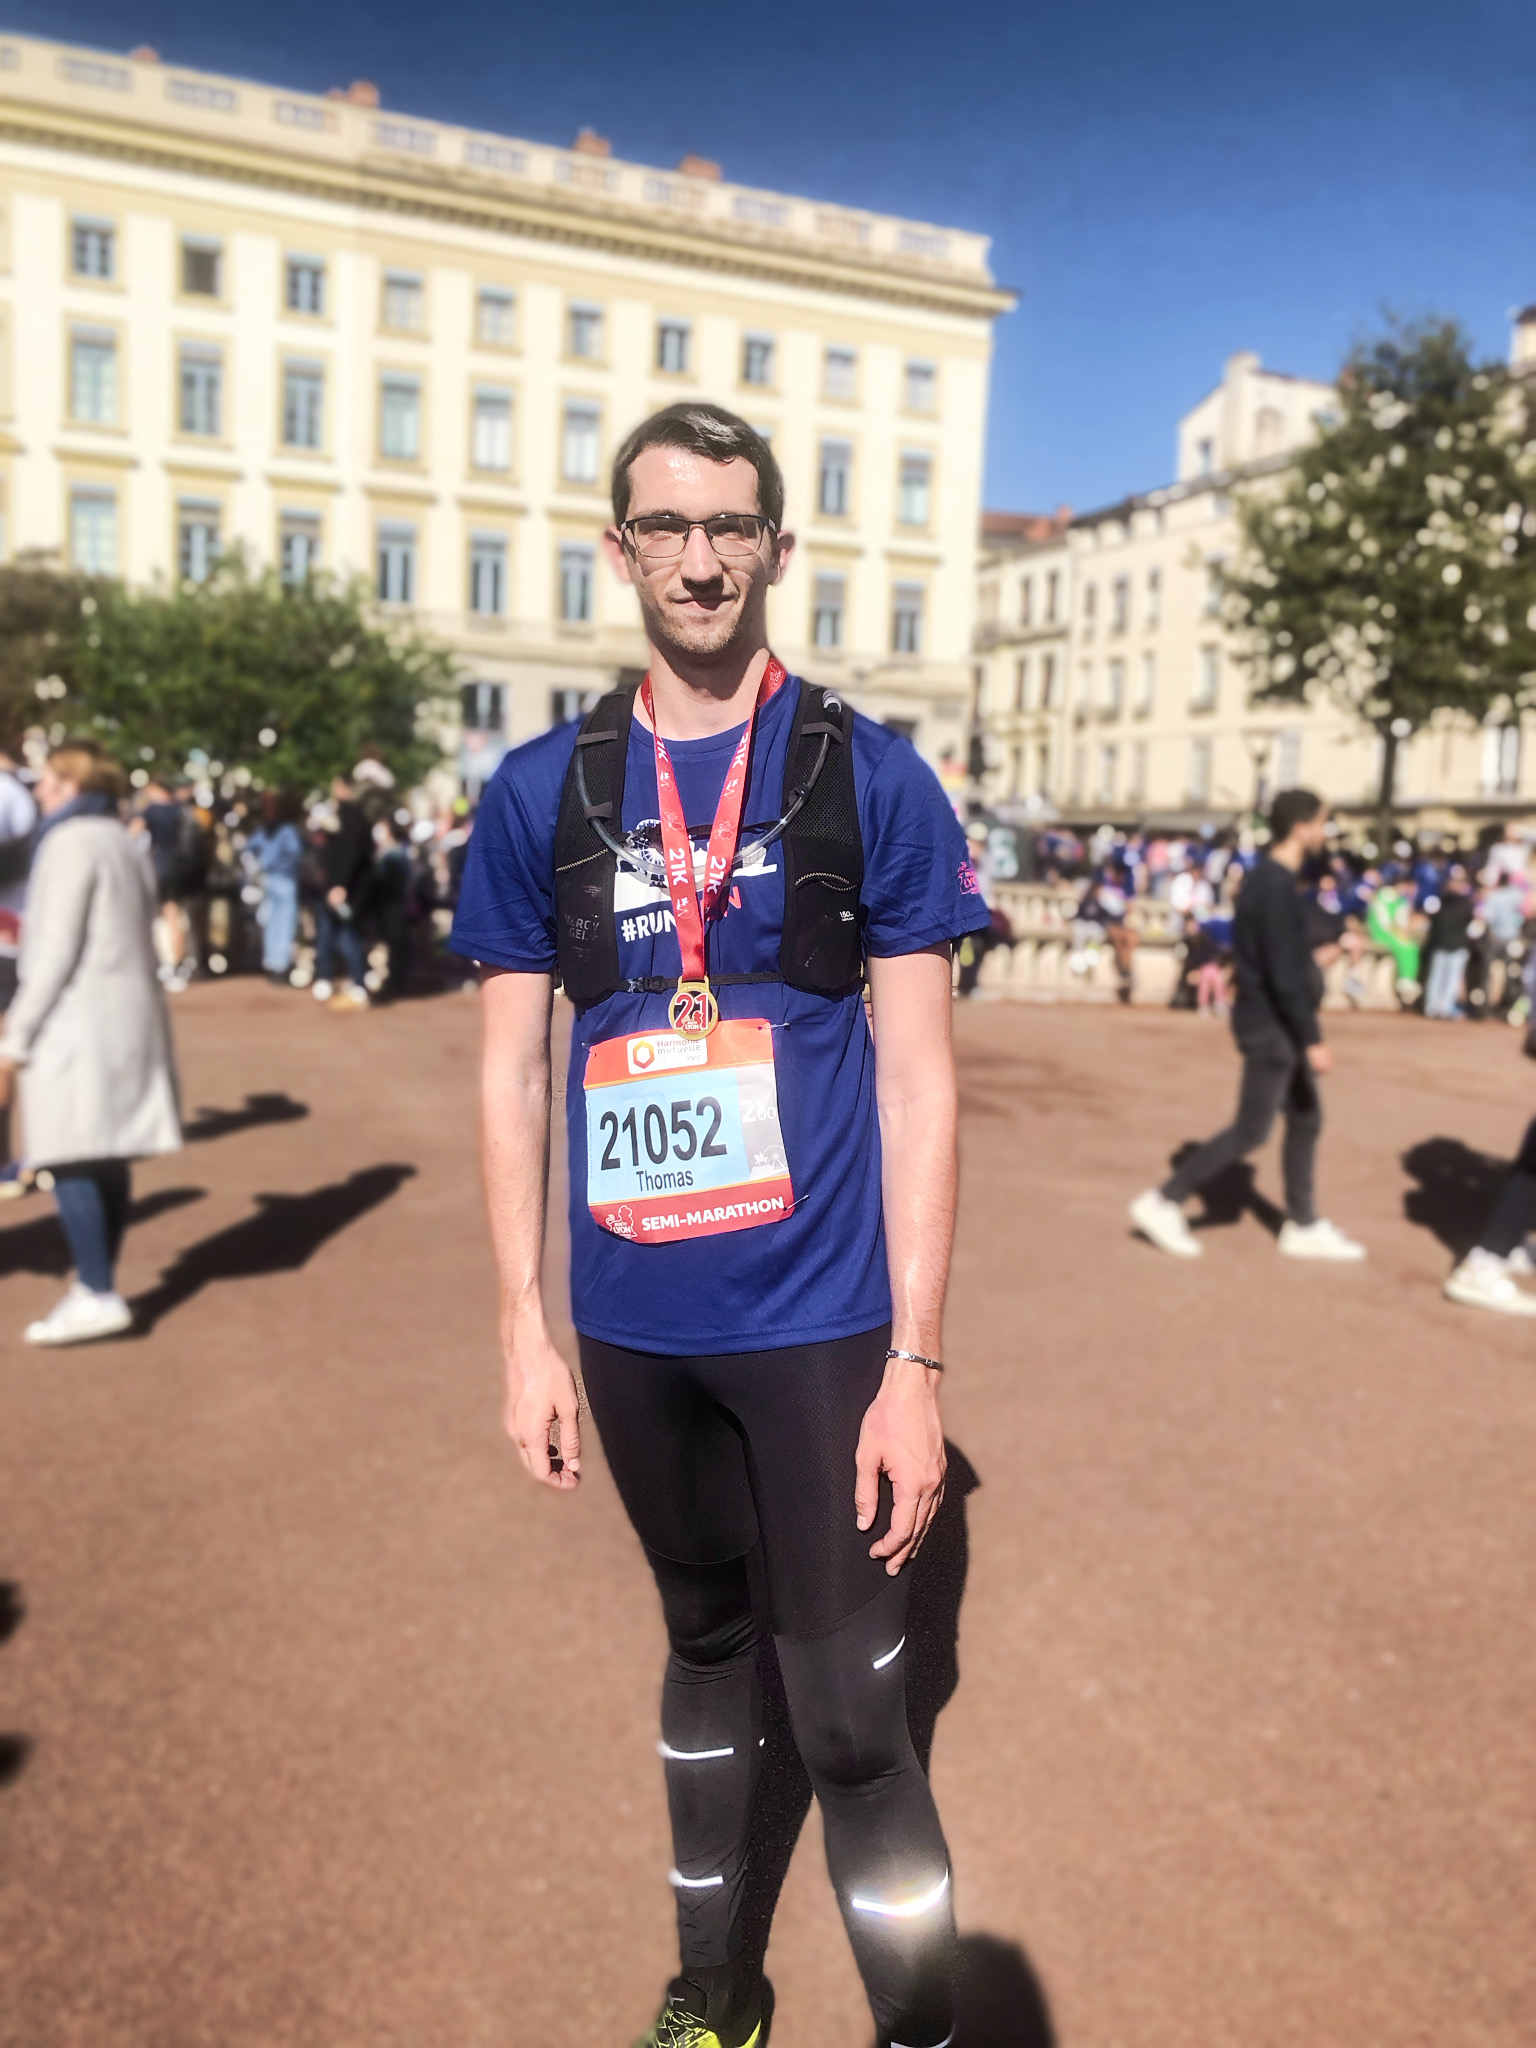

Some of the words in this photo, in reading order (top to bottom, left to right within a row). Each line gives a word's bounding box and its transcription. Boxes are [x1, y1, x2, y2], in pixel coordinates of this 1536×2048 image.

[669, 848, 689, 886] 21K
[706, 855, 727, 894] 21K
[674, 992, 709, 1030] 21
[657, 1044, 701, 1055] mutuelle
[599, 1096, 727, 1171] 21052
[636, 1169, 694, 1192] Thomas
[641, 1196, 785, 1232] SEMI-MARATHON
